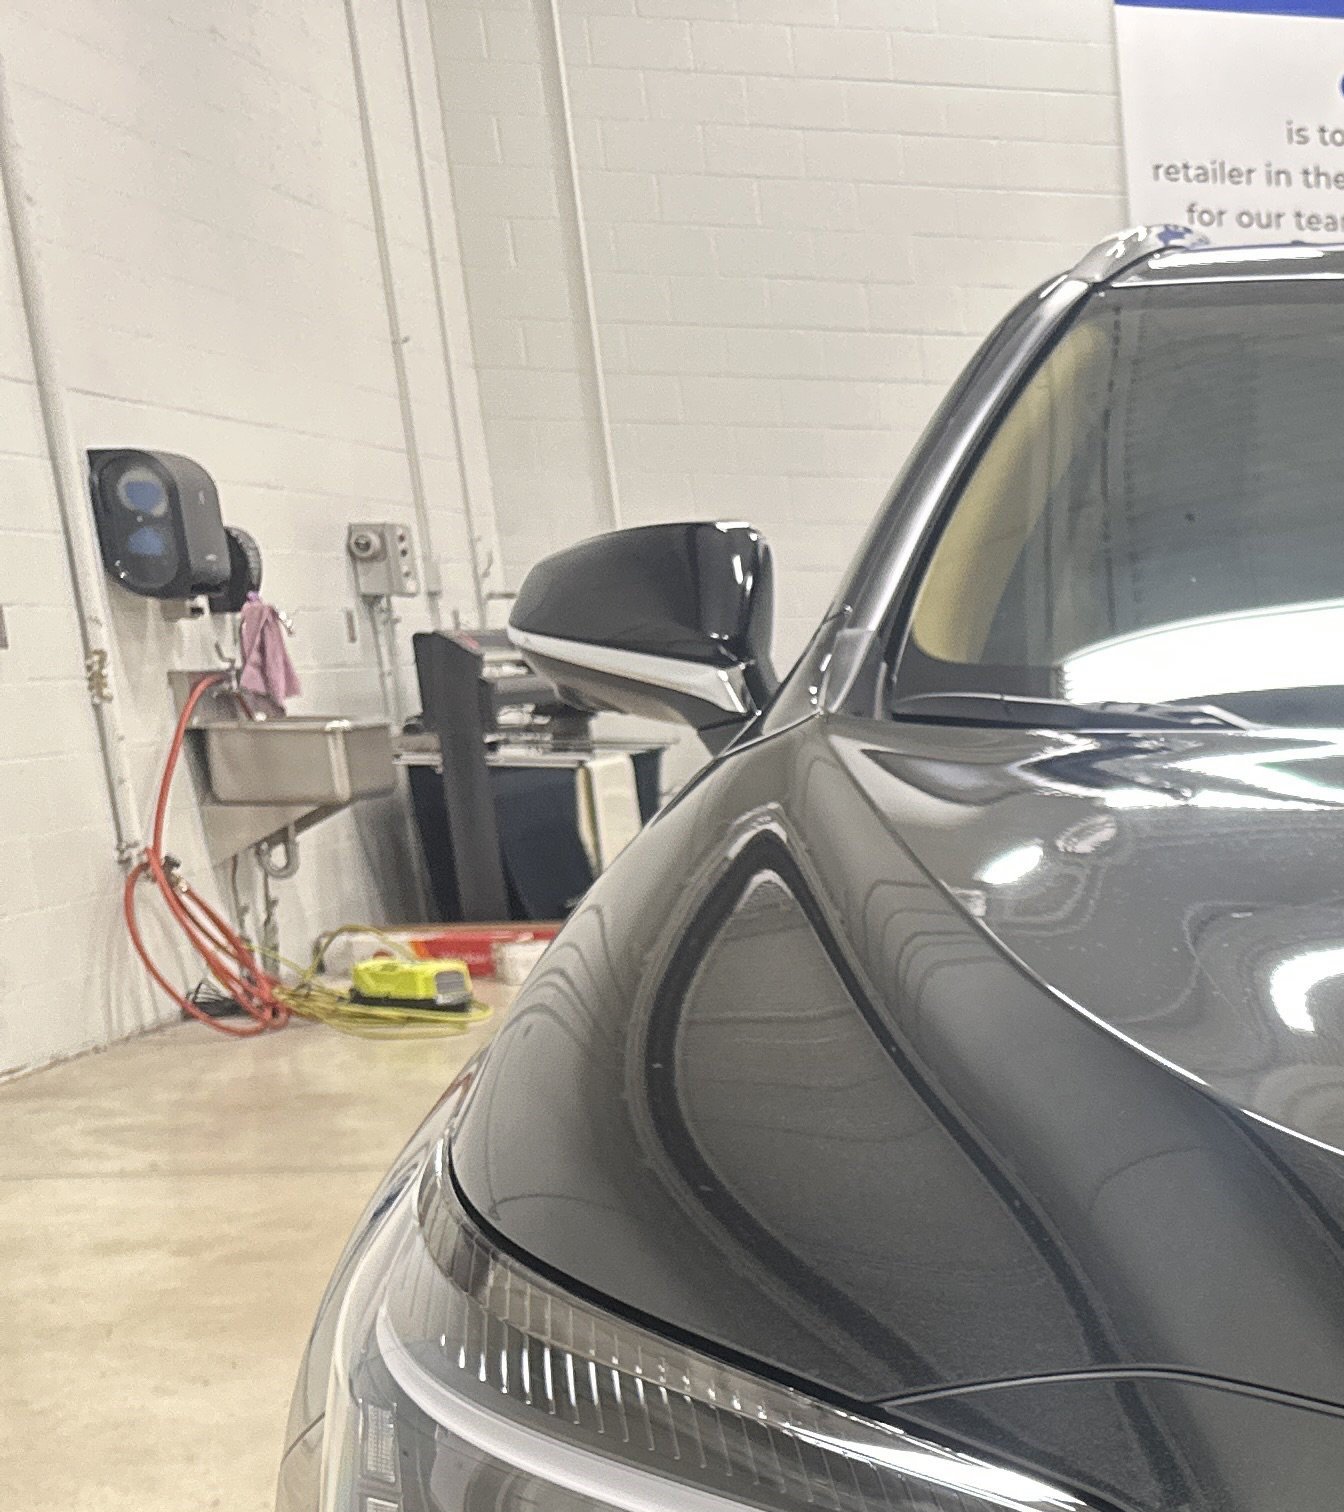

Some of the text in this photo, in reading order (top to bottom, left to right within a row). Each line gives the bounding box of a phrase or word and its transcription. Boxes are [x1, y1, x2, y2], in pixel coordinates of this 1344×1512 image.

[1286, 120, 1309, 146] is
[1152, 159, 1256, 186] retailer
[1265, 162, 1292, 188] in
[1186, 202, 1227, 228] for
[1235, 207, 1286, 230] our
